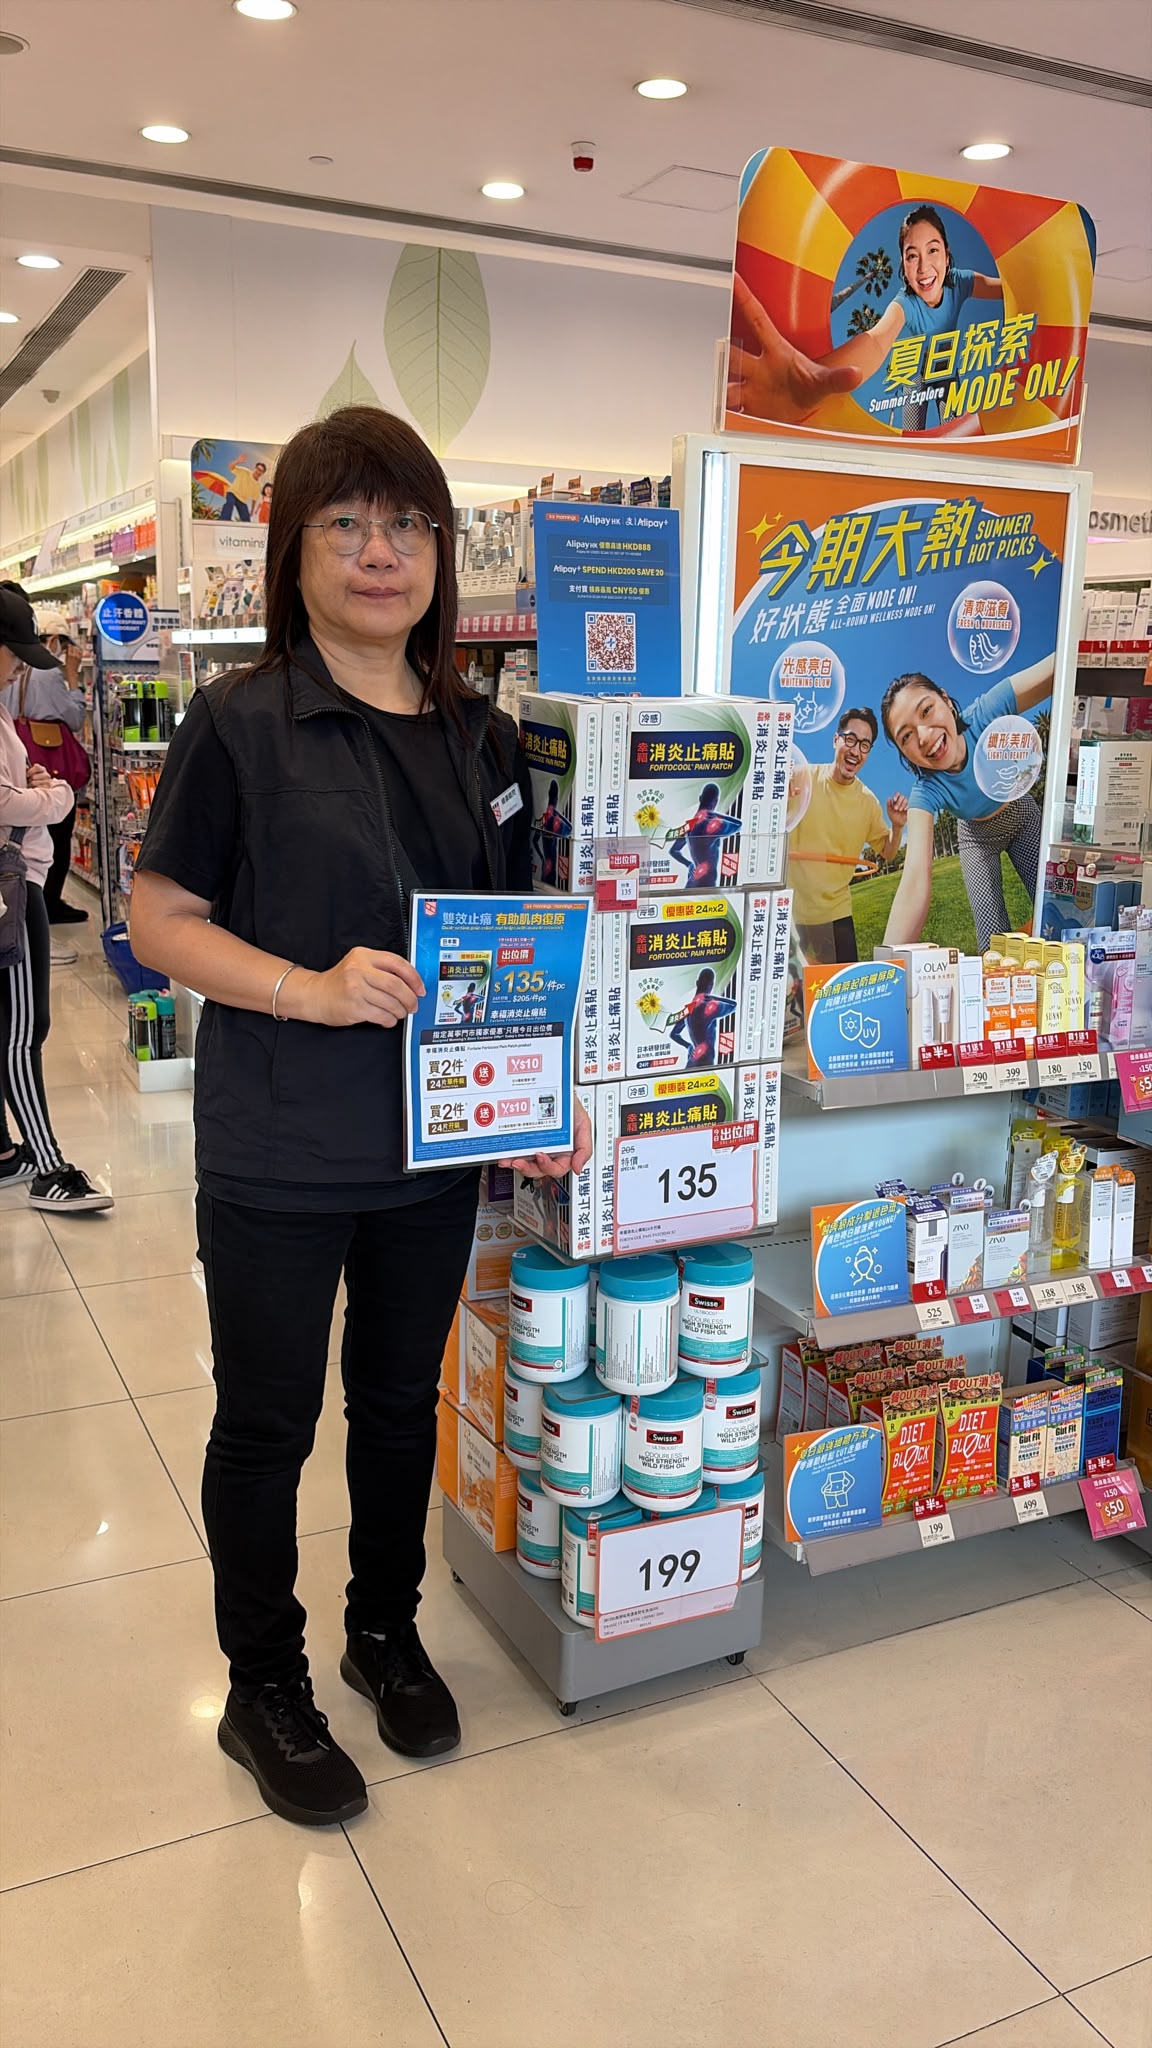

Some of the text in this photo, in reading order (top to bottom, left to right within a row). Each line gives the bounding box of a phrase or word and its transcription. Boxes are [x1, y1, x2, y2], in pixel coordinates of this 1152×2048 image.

[884, 313, 1037, 391] 夏日探索
[944, 357, 1080, 419] MODE ON!
[869, 387, 945, 412] Summer Explore
[975, 515, 1032, 538] SUMMER
[219, 536, 265, 549] vitamins
[622, 542, 651, 551] HKD888
[759, 499, 976, 597] 今期大熱
[968, 536, 1036, 563] HOT PICKS
[582, 565, 606, 574] SPEND
[607, 566, 636, 575] HKD200
[637, 567, 654, 576] SAVE
[612, 586, 637, 594] CNY50
[749, 585, 917, 644] 好狀態 全面 MODE ON!
[962, 599, 1008, 617] 清爽滋養
[830, 603, 936, 630] ALL-ROUND WELLNESS MODE ON!
[957, 619, 974, 629] FRESH
[982, 619, 1012, 630] NOURISHED
[782, 657, 832, 676] 光感亮白
[780, 677, 831, 688] WHITENING GLOW
[649, 742, 736, 762] 消炎止痛貼
[987, 751, 1028, 761] LIGHT BEAUTY
[693, 763, 711, 772] PAIN
[711, 763, 734, 771] PATCH
[752, 723, 770, 800] 消炎止痛貼
[772, 723, 790, 800] 消炎止痛貼
[579, 796, 595, 874] 消炎止痛貼
[666, 904, 694, 917] 優惠裝
[443, 912, 565, 925] 雙效止痛 有助肌肉復原
[648, 928, 728, 952] 消炎止痛貼
[749, 908, 766, 982] 消炎止痛貼
[772, 908, 788, 980] 消炎止痛貼
[501, 949, 529, 959] 出位價
[690, 949, 706, 958] PAIN
[706, 947, 726, 956] PATCH
[924, 962, 948, 973] OLAY
[504, 970, 544, 993] 135
[863, 984, 888, 997] SAY NO!
[490, 1008, 547, 1019] 幸福消炎止痛貼
[585, 989, 597, 1063] 消炎止痛貼
[608, 987, 621, 1061] 消炎止痛貼
[863, 1028, 876, 1038] UV
[479, 1066, 489, 1078] 送
[1047, 1064, 1062, 1075] 180
[1078, 1061, 1093, 1071] 150
[972, 1072, 988, 1082] 290
[1006, 1068, 1021, 1078] 399
[658, 1082, 686, 1095] 優惠裝
[480, 1107, 489, 1119] 送
[639, 1104, 718, 1129] 消炎止痛貼
[765, 1081, 777, 1149] 消炎止痛貼
[720, 1124, 755, 1140] 出位價
[621, 1146, 635, 1154] 205
[621, 1157, 638, 1166] 特價
[658, 1162, 717, 1203] 135
[578, 1168, 591, 1239] 消炎止痛貼
[1041, 1288, 1056, 1298] 188
[1071, 1283, 1086, 1293] 188
[694, 1298, 719, 1307] Swisse
[927, 1307, 942, 1318] 525
[685, 1325, 699, 1333] WILD
[732, 1406, 753, 1416] Swisse
[958, 1411, 987, 1432] DIET
[900, 1423, 926, 1446] DIET
[1055, 1424, 1077, 1436] Gut Fit
[652, 1433, 678, 1442] Swisse
[1019, 1432, 1041, 1445] Gut Fit
[639, 1455, 689, 1465] HIGH STRENGTH
[642, 1461, 658, 1469] WILD
[1024, 1499, 1037, 1510] 499
[1104, 1498, 1125, 1517] $50
[929, 1523, 943, 1534] 199
[639, 1549, 700, 1591] 199
